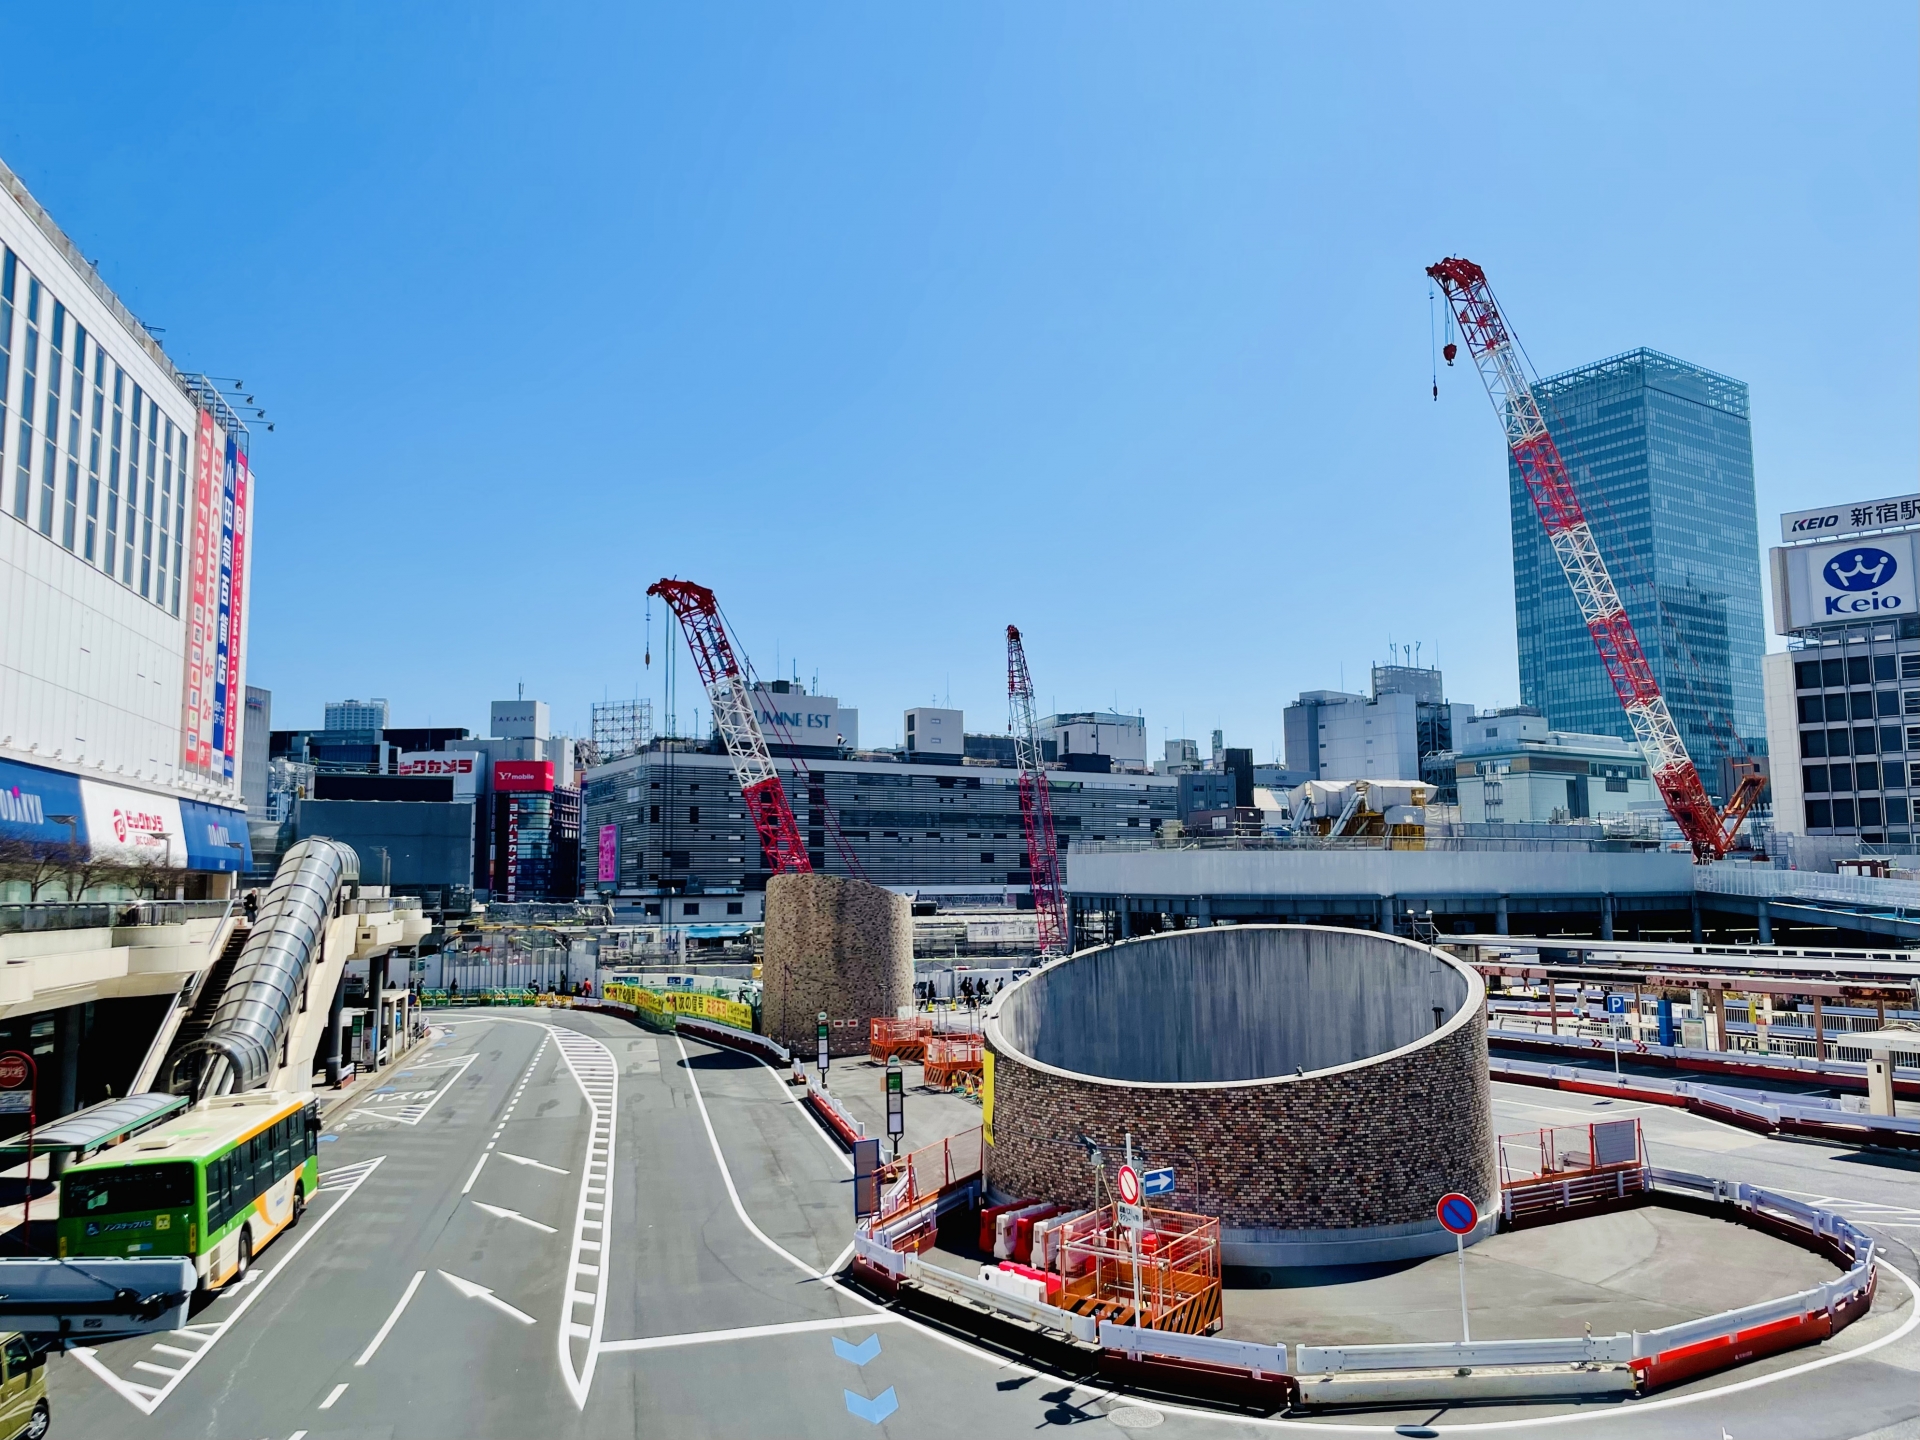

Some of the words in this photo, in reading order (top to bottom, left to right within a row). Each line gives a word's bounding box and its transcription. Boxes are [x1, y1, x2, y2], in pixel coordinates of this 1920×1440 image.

[1791, 514, 1839, 532] KEIO
[1851, 499, 1920, 527] 新宿駅
[206, 447, 223, 642] BicCamera
[217, 459, 234, 686] 小田急百貨店
[1824, 591, 1902, 616] Keio
[492, 715, 535, 723] TAKANO
[754, 709, 803, 727] UMINE
[807, 713, 832, 729] EST
[125, 810, 164, 833] ビックカメラ
[679, 994, 704, 1013] 次の信号
[706, 997, 727, 1019] 左折不可
[1611, 997, 1622, 1012] P
[103, 1220, 153, 1232] ノンステップバス
